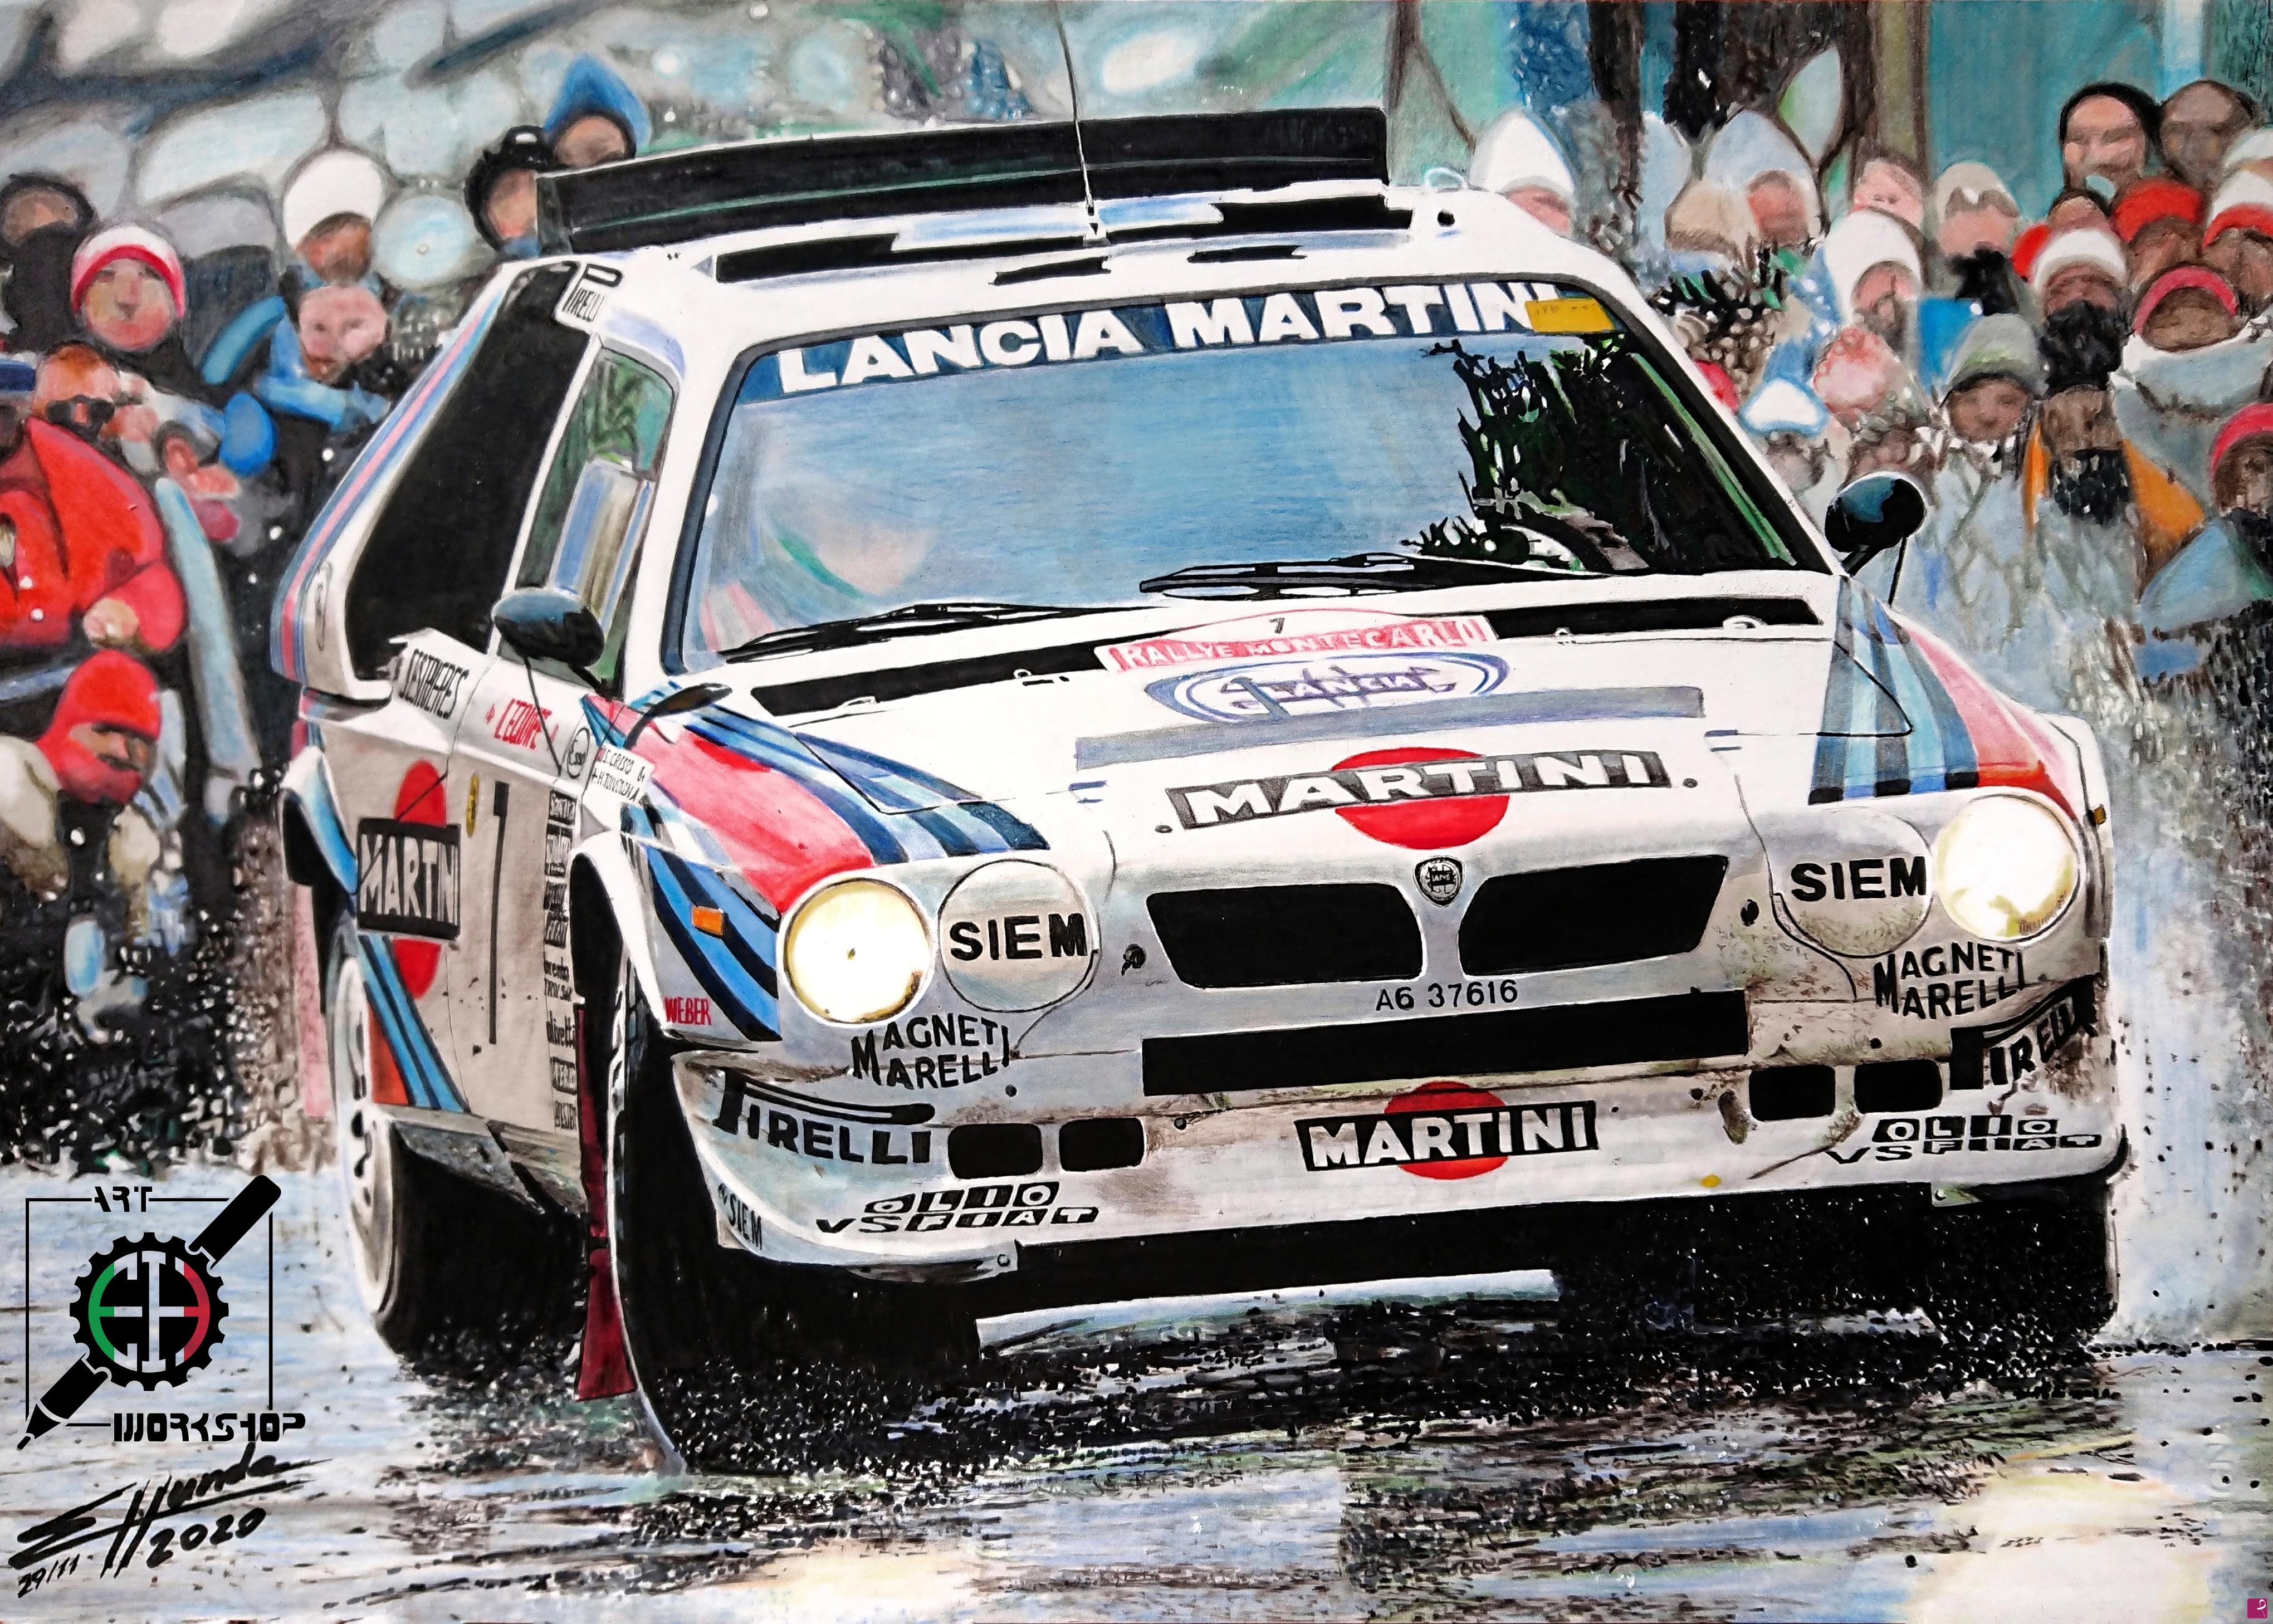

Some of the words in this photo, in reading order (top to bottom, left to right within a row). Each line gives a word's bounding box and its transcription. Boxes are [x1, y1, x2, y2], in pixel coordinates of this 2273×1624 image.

[779, 310, 1144, 393] LANCIA
[1118, 642, 1233, 668] RALLYE
[1181, 752, 1656, 825] MARTINI
[1790, 856, 1927, 902] SIEM
[949, 913, 1088, 962] SIEM
[1376, 986, 1415, 1011] A6
[1428, 979, 1518, 1008] 37616
[1874, 942, 2025, 998] MAGNETI
[1874, 961, 2025, 1020] MARELLI
[664, 997, 712, 1026] WEBER
[851, 1012, 1010, 1067] MAGNETI
[851, 1030, 1010, 1090] MARELLI
[712, 1068, 936, 1164] PIRELLI
[1308, 1106, 1588, 1168] MARTINI
[1871, 1114, 2059, 1143] OLIO
[728, 1193, 762, 1250] SIEM
[864, 1181, 1059, 1214] OLIO
[145, 1507, 267, 1568] 2020
